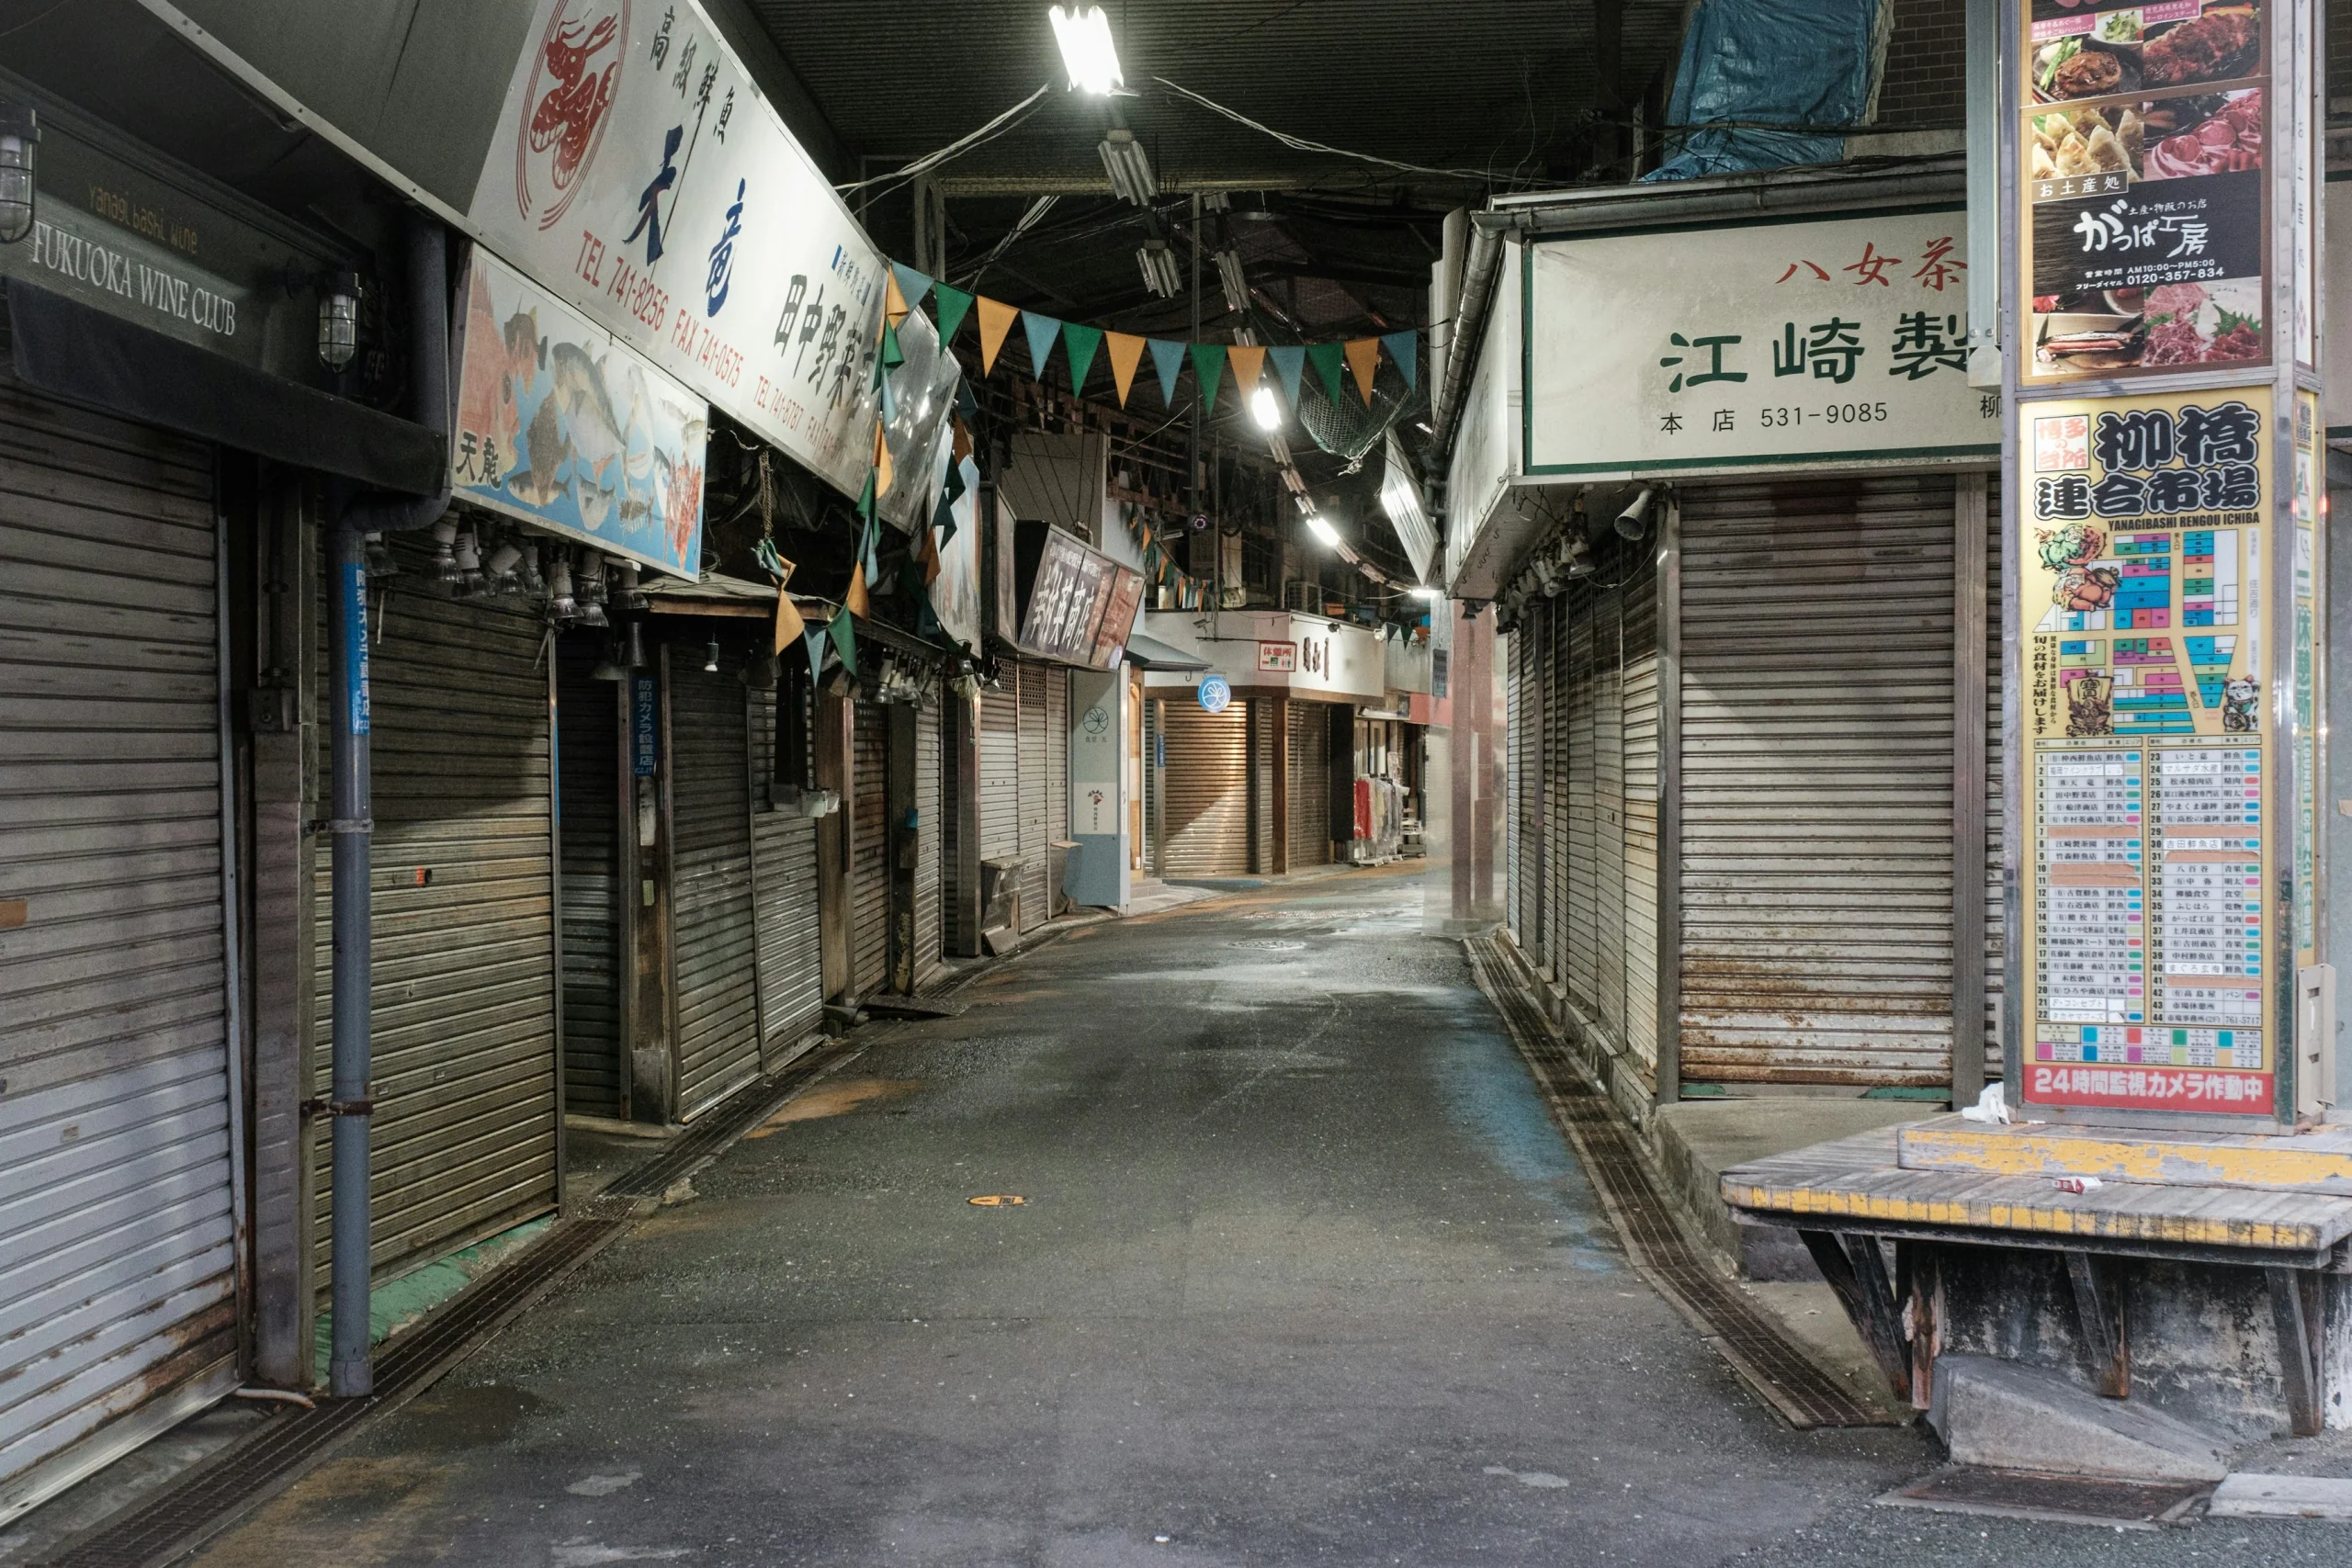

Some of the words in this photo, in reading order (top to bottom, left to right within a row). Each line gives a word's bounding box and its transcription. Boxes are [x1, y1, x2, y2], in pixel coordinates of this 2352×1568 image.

[650, 6, 735, 145] 高級鮮魚
[2040, 176, 2120, 197] お土産処
[2074, 199, 2209, 258] がっぱ工房
[33, 220, 132, 298] FUKUOKA
[140, 265, 187, 318] WINE
[192, 288, 235, 335] CLUB
[1775, 236, 1968, 292] 八女茶
[2076, 280, 2123, 290] フリーダイヤル
[2127, 267, 2224, 285] 0120-357-834
[2086, 268, 2122, 278] 営業時間
[575, 230, 606, 288] TEL
[607, 256, 669, 331] 741-8256
[671, 309, 699, 355] FAX
[695, 328, 744, 388] 741-0575
[753, 376, 771, 409] TEL
[1760, 401, 1888, 428] 531-9085
[2039, 418, 2086, 439] 博多
[2094, 401, 2260, 471] 柳橋
[457, 431, 502, 490] 天龍
[2038, 448, 2086, 469] 台所
[2035, 464, 2260, 519] 連合市場
[2109, 516, 2177, 531] YANAGIBASHI
[2180, 514, 2220, 527] RENGOU
[2223, 513, 2260, 525] ICHIBA
[2033, 636, 2047, 734] 旬の食材をお届けします
[639, 680, 654, 766] 防犯カメラ設置店
[2035, 1068, 2263, 1101] 24時間監視カメラ作動中
